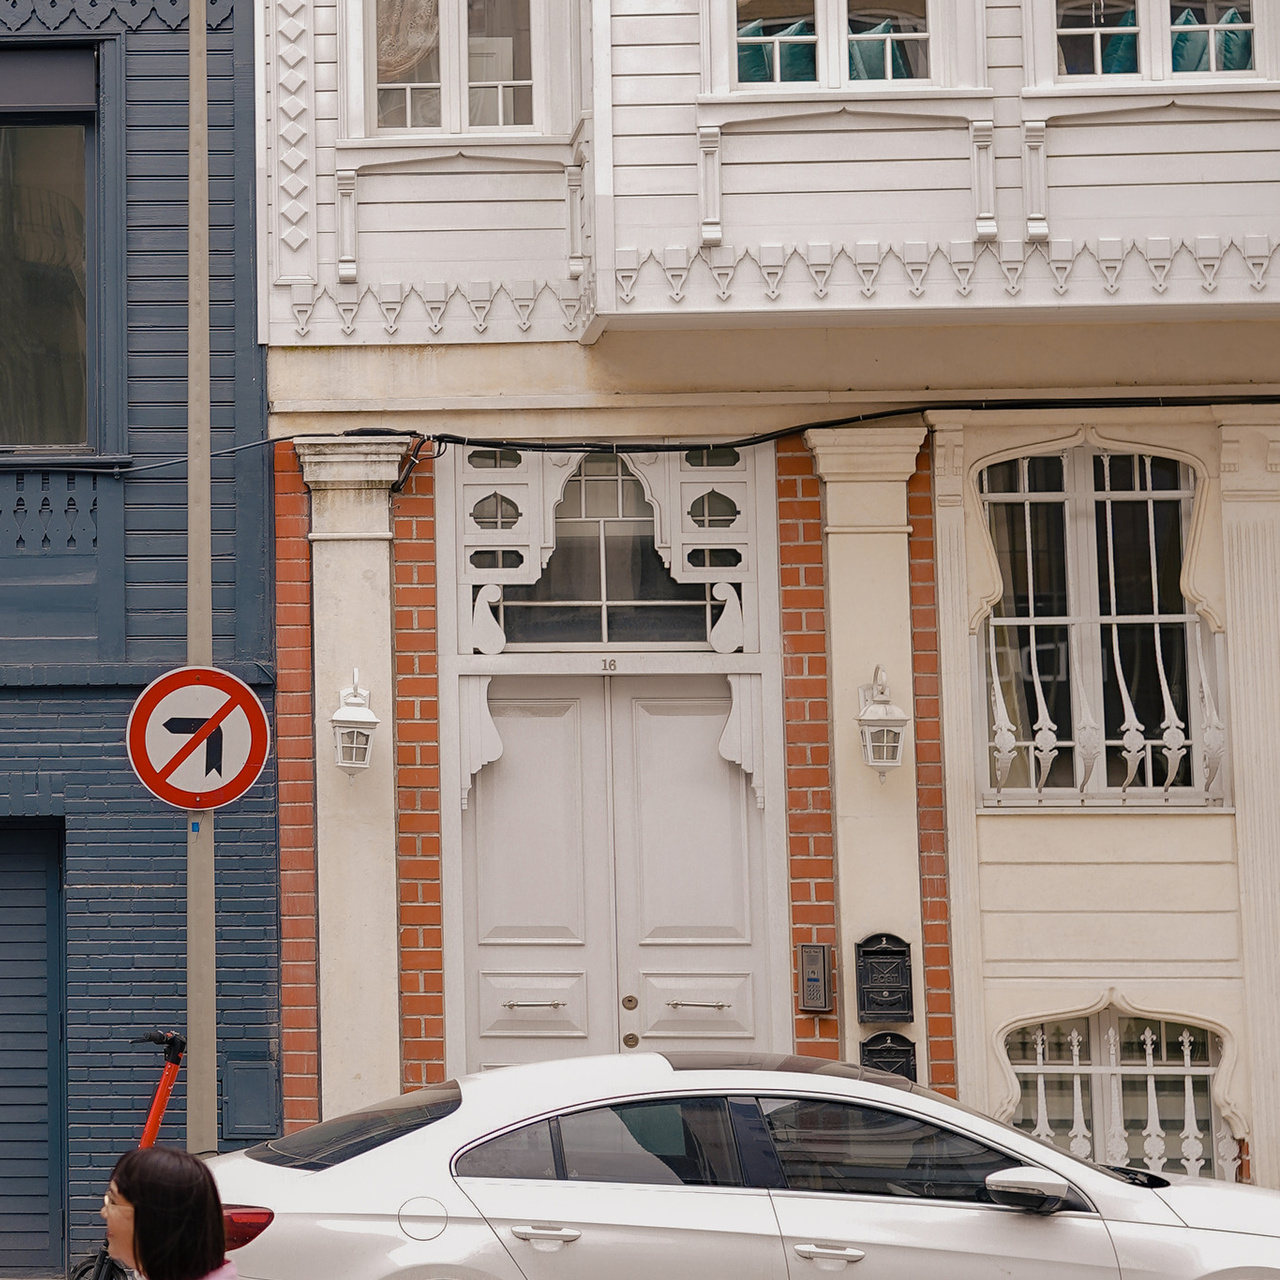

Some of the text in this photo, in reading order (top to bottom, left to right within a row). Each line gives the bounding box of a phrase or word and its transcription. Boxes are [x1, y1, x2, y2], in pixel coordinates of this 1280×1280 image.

[601, 658, 617, 671] 16
[881, 937, 887, 945] 3
[885, 1035, 892, 1043] 2
